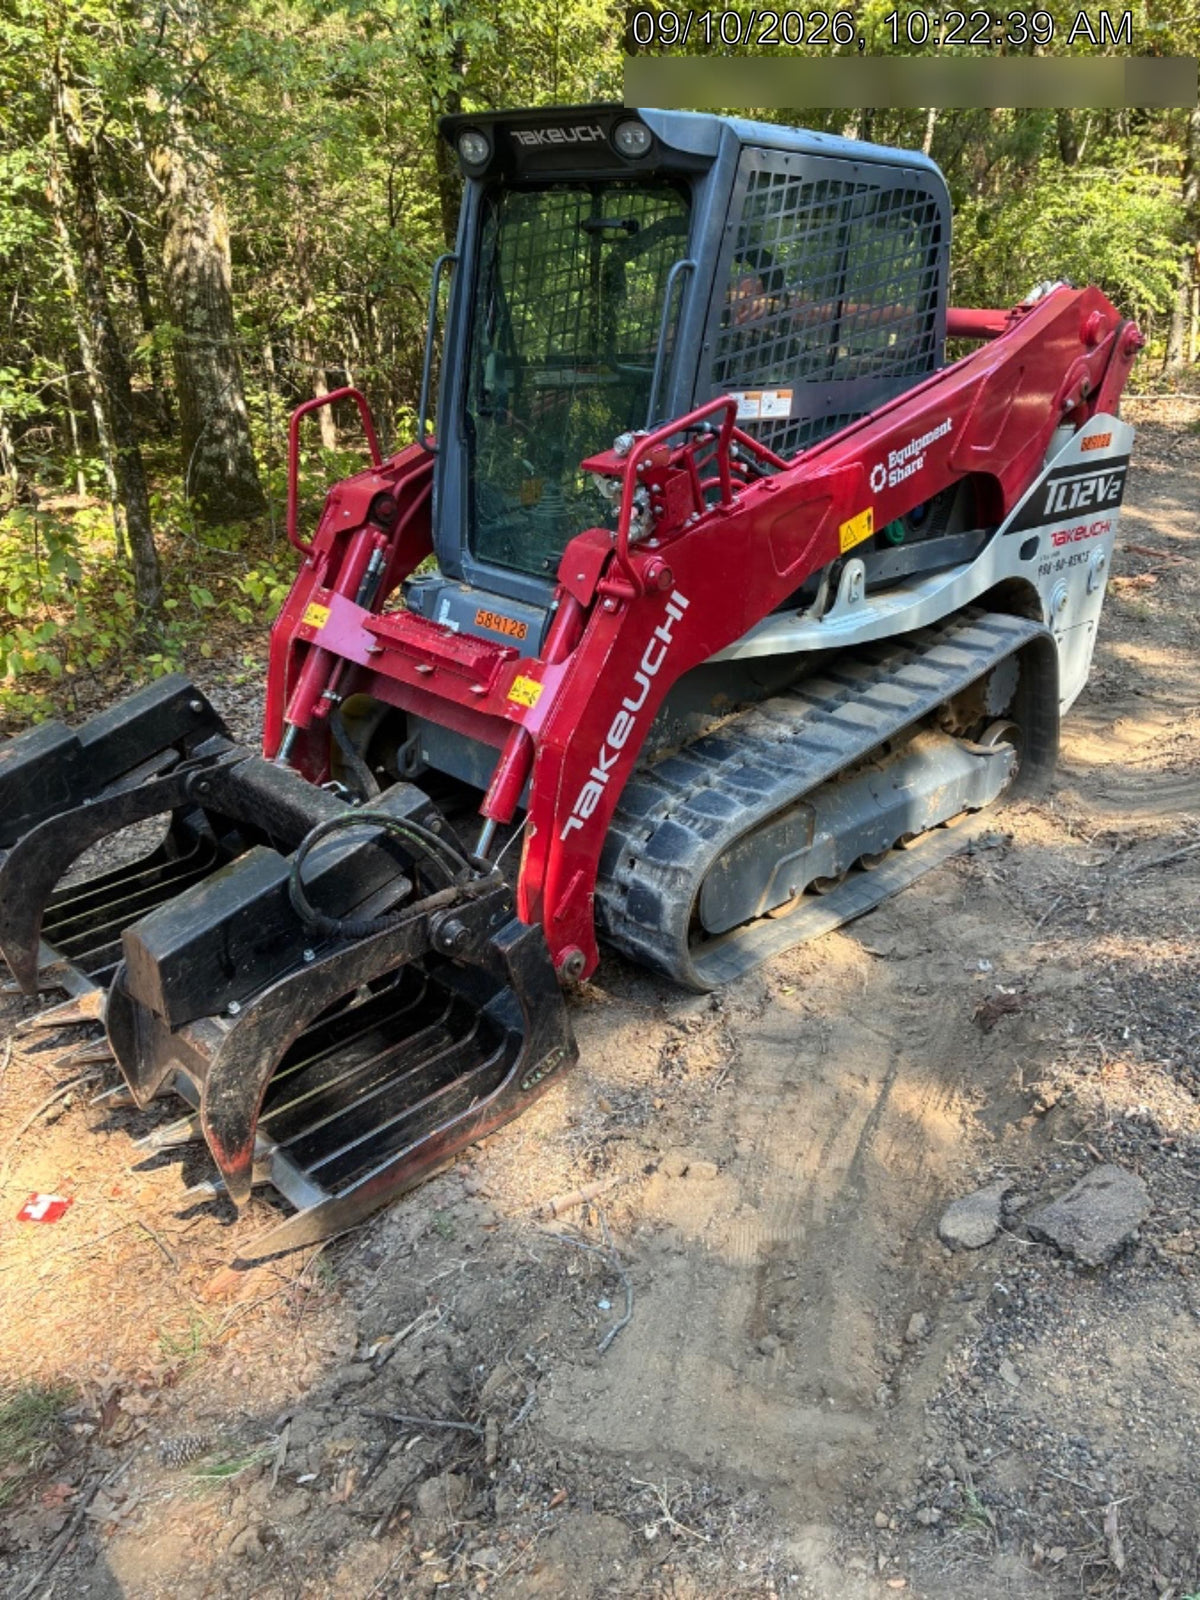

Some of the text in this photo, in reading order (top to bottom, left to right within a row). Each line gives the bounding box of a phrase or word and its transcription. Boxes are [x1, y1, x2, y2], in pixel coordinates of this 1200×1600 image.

[888, 417, 952, 468] Equipment
[888, 456, 924, 487] Share
[1043, 465, 1126, 515] TL12V2
[476, 609, 527, 639] 589128
[559, 589, 690, 841] TAKEUCHI
